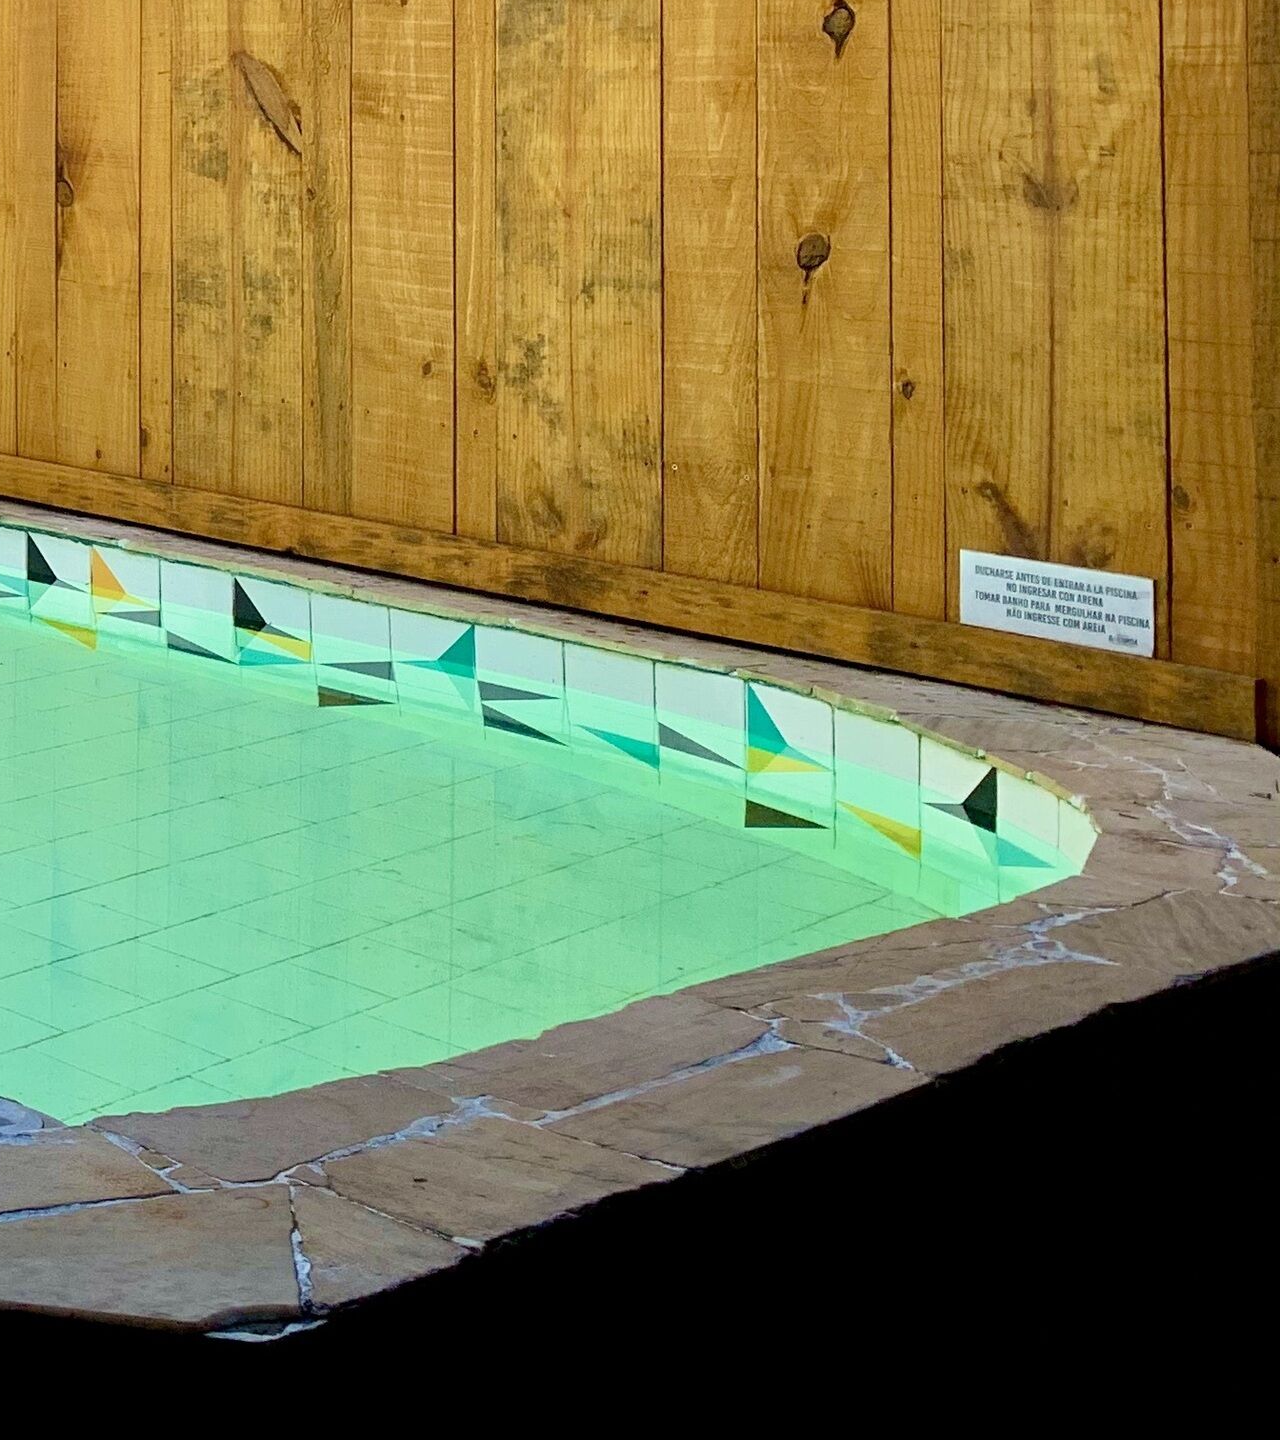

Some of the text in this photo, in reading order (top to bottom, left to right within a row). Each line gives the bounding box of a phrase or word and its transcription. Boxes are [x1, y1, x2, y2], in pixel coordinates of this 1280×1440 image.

[975, 565, 1138, 600] DUCHARSE ANTES DE ENTRAR A LA PISCINA
[1006, 582, 1104, 607] NO INGRESAR CON ARENA
[975, 590, 1151, 630] TOMAR BANHO PARA MERGULHAR NA PISCINA
[1006, 607, 1106, 634] NÃO INGRESSE COM AREIA
